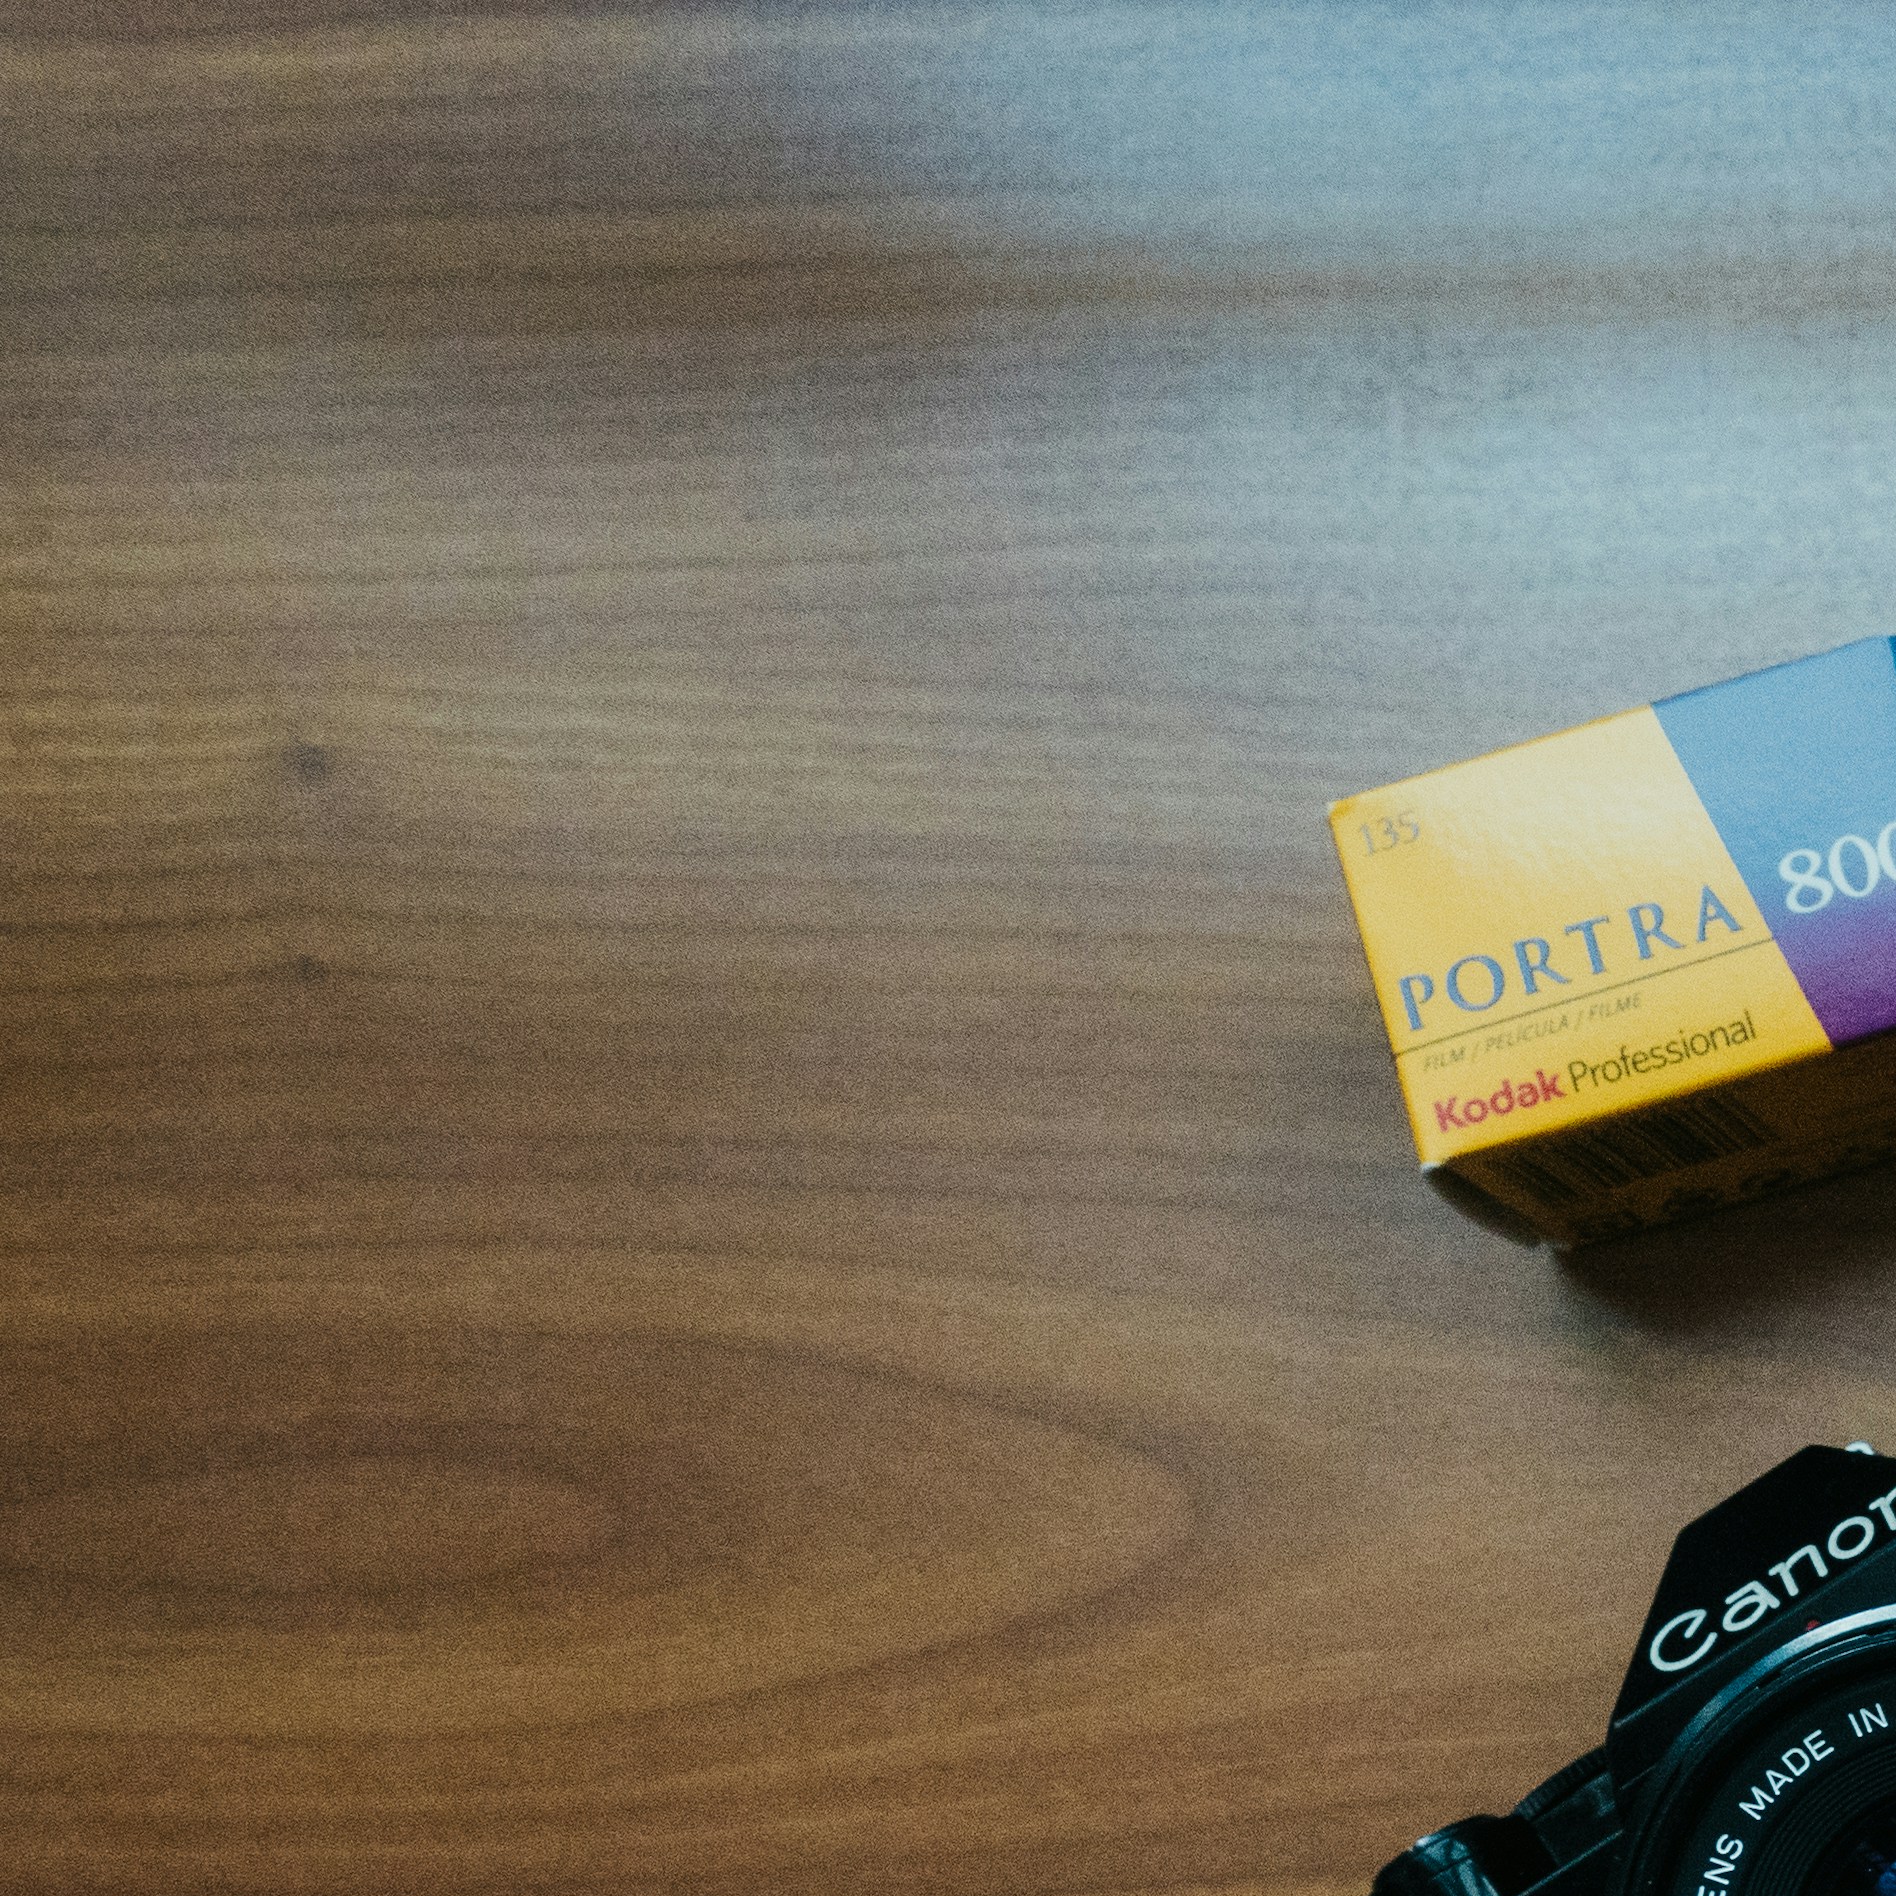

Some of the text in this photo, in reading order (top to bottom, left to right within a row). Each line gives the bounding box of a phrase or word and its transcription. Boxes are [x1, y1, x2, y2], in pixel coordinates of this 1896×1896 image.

[1360, 811, 1420, 856] 135
[1399, 885, 1743, 1032] PORTRA
[1433, 1010, 1757, 1133] Kodak Professional
[1738, 1729, 1835, 1821] MADE
[1848, 1703, 1889, 1737] IN
